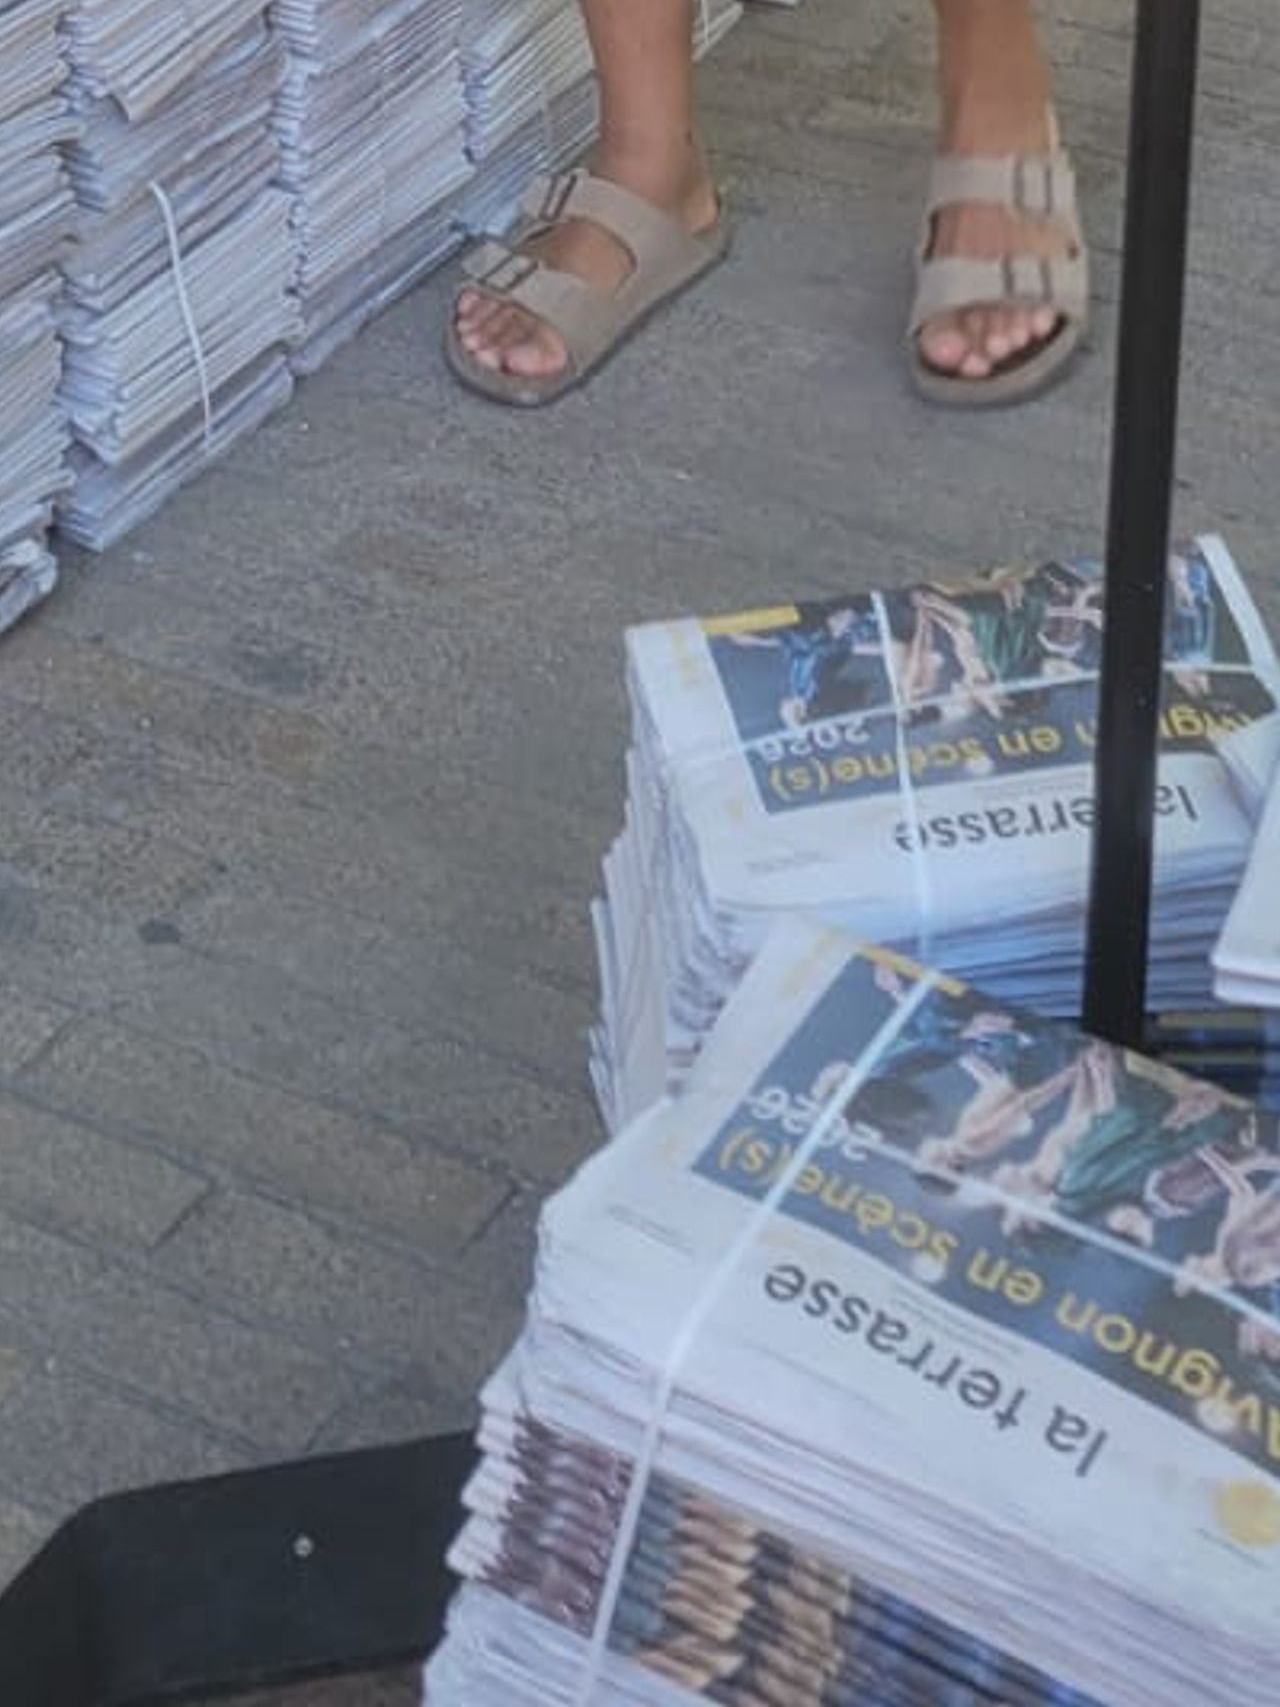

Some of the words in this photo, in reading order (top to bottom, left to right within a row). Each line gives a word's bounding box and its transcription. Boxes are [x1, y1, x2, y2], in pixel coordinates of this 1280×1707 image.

[998, 723, 1062, 760] en
[893, 793, 1102, 853] errasse
[719, 1125, 961, 1268] scène(s)
[965, 1247, 1045, 1306] en
[762, 1262, 1027, 1432] terrasse
[1043, 1404, 1110, 1479] la
